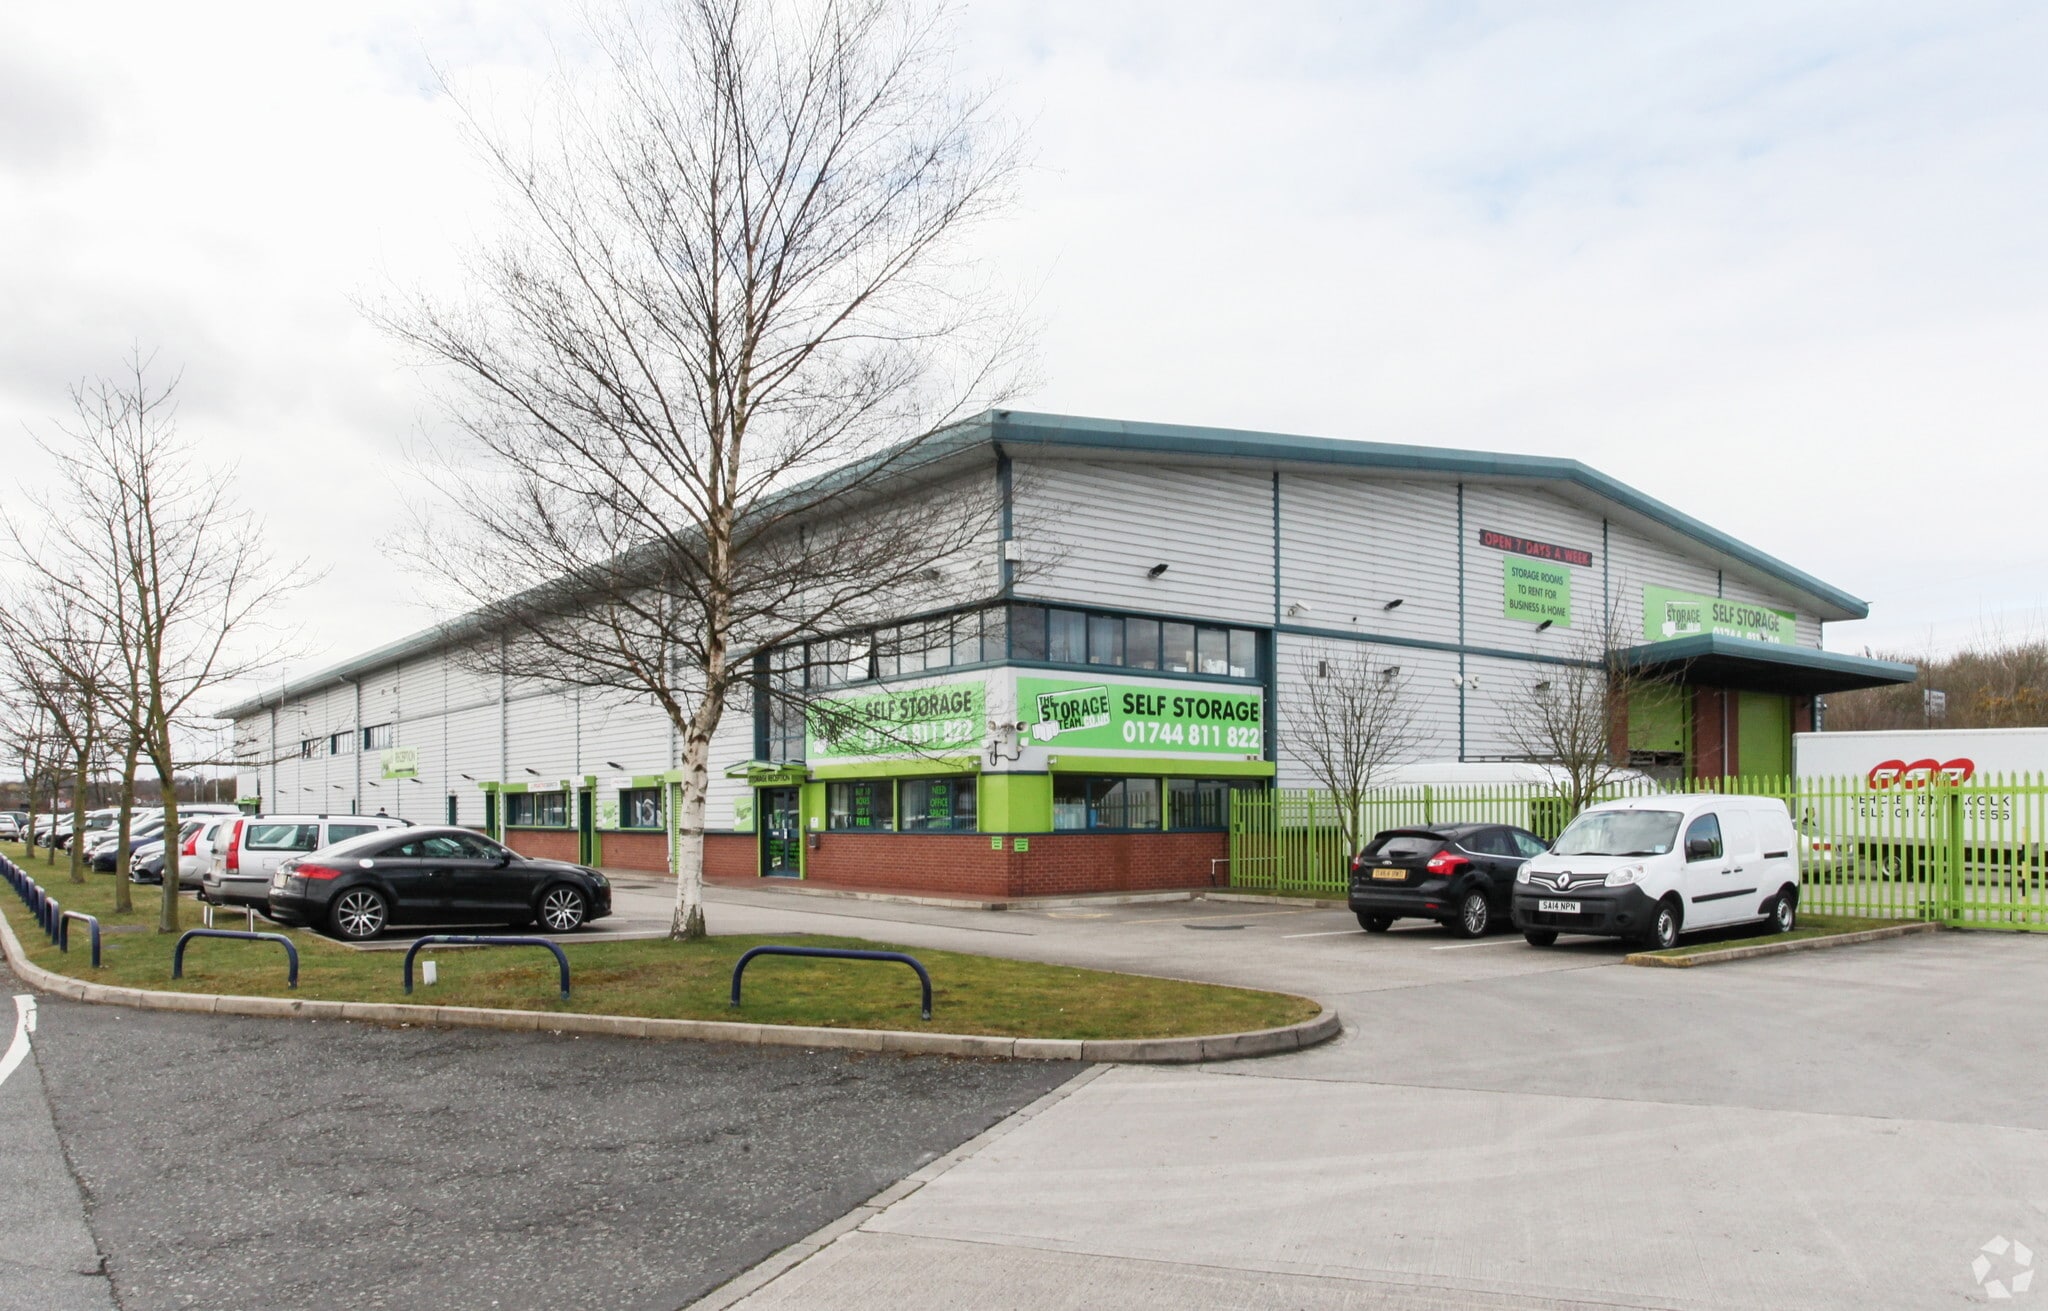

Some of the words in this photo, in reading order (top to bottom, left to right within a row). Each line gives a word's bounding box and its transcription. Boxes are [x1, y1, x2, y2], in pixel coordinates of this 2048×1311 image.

[1484, 532, 1512, 549] OPEN
[1517, 539, 1523, 551] 7
[1526, 541, 1551, 557] DAYS
[1554, 548, 1560, 559] A
[1564, 550, 1590, 564] WEEK
[1511, 567, 1539, 581] STORAGE
[1541, 572, 1563, 585] ROOMS
[1518, 584, 1526, 593] TO
[1528, 587, 1543, 597] RENT
[1545, 589, 1557, 599] FOR
[1509, 598, 1540, 613] BUSINESS
[1541, 604, 1546, 614] &
[1547, 605, 1566, 617] HOME
[1667, 608, 1700, 623] STORAGE
[1712, 603, 1734, 623] SELF
[1737, 607, 1779, 632] STORAGE
[865, 701, 895, 722] SELF
[900, 691, 972, 719] STORAGE
[1039, 695, 1054, 706] THE
[1041, 696, 1108, 722] STORAGE
[1123, 693, 1166, 716] SELF
[1173, 697, 1259, 722] STORAGE
[1123, 720, 1184, 745] 01744
[1188, 724, 1220, 747] 811
[1227, 726, 1260, 748] 822
[767, 774, 791, 782] RECEPTION
[932, 786, 946, 795] NEED
[856, 817, 870, 826] FREE
[1543, 901, 1559, 911] SA14
[1561, 902, 1576, 911] NPN
